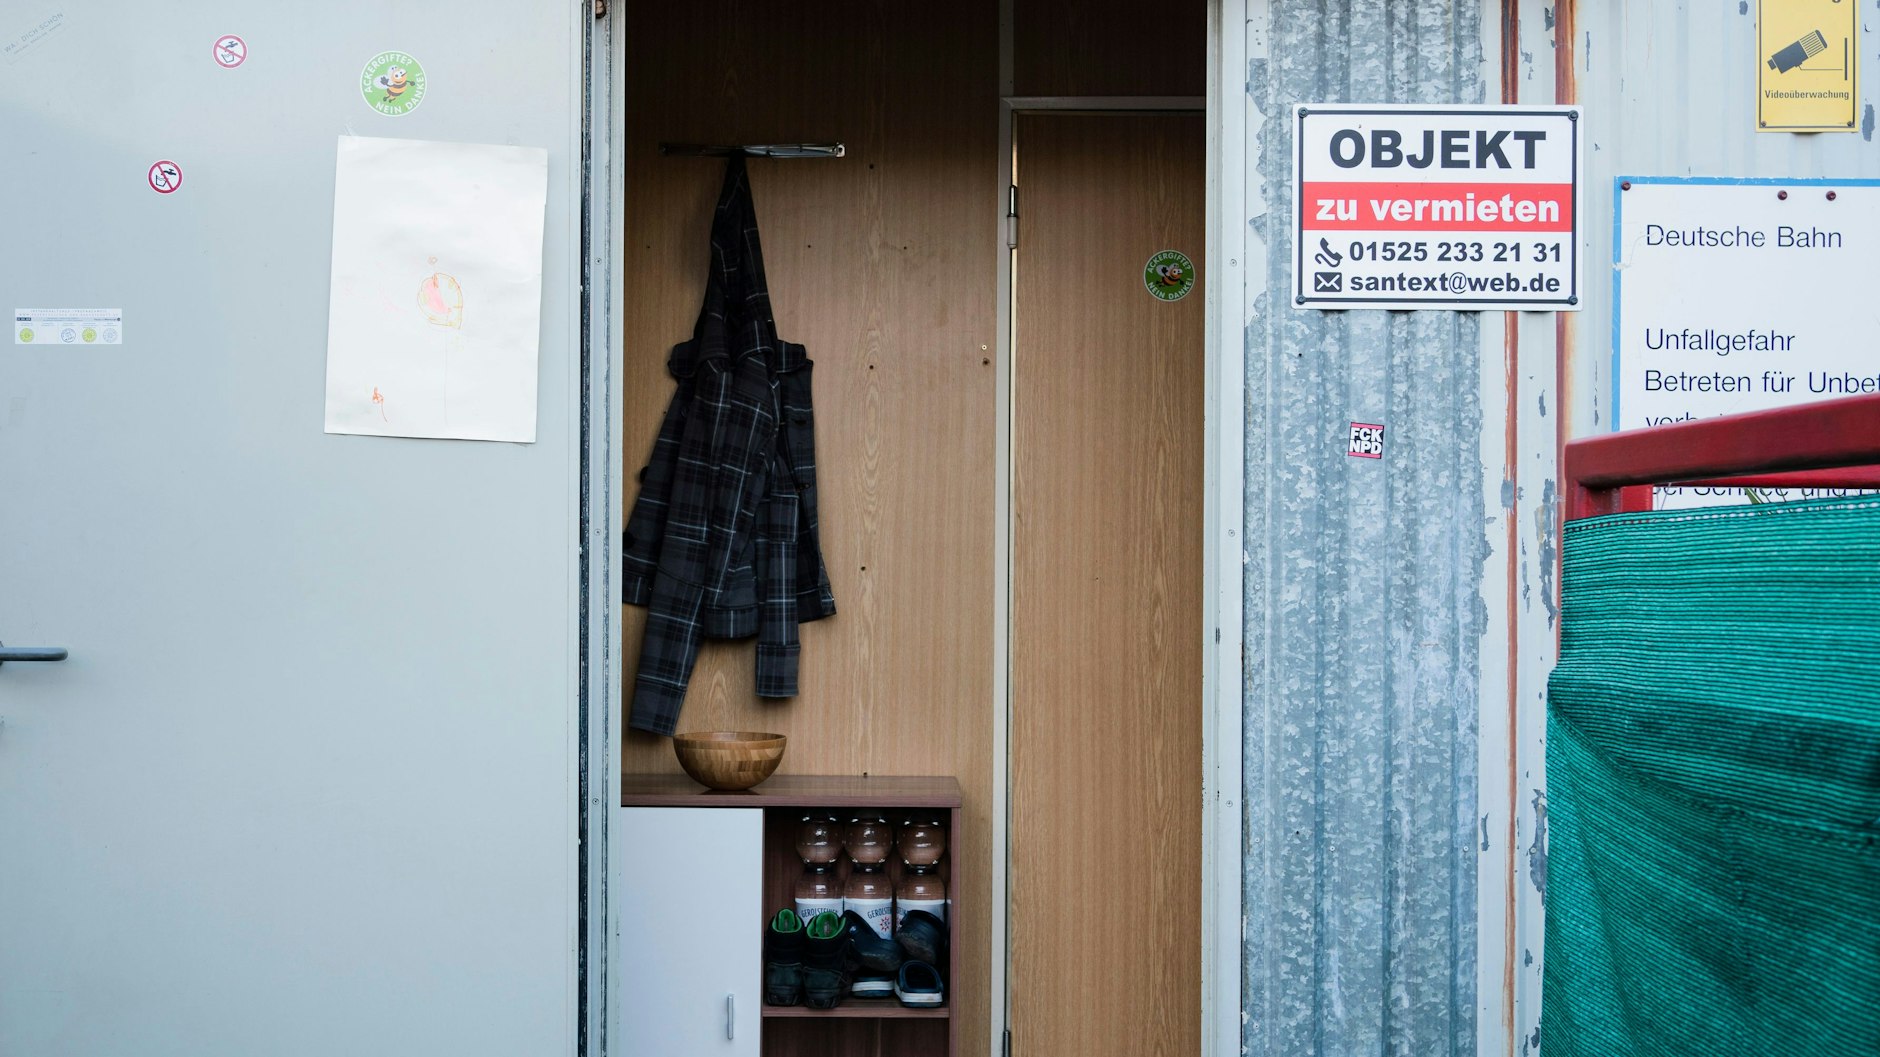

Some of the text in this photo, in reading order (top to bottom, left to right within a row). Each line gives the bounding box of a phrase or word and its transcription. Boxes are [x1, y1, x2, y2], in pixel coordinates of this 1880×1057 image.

[363, 53, 413, 93] ACKERGIFTE?
[375, 72, 425, 114] NEIN DANKE!
[1764, 90, 1850, 100] Videoüberwachung
[1329, 128, 1547, 169] OBJEKT
[1316, 192, 1560, 223] zu vermieten
[1646, 224, 1842, 248] Deutsche Bahn
[1147, 252, 1192, 274] ACKERGIFTE?
[1349, 241, 1561, 263] 01525 233 21 31
[1148, 278, 1193, 300] NEIN DANKE!
[1349, 271, 1561, 294] santext@web.de
[1646, 328, 1796, 356] Unfallgefahr
[1645, 370, 1751, 392] Betreten
[1761, 371, 1796, 393] für
[1350, 427, 1383, 442] FCK
[1349, 439, 1382, 454] NPD
